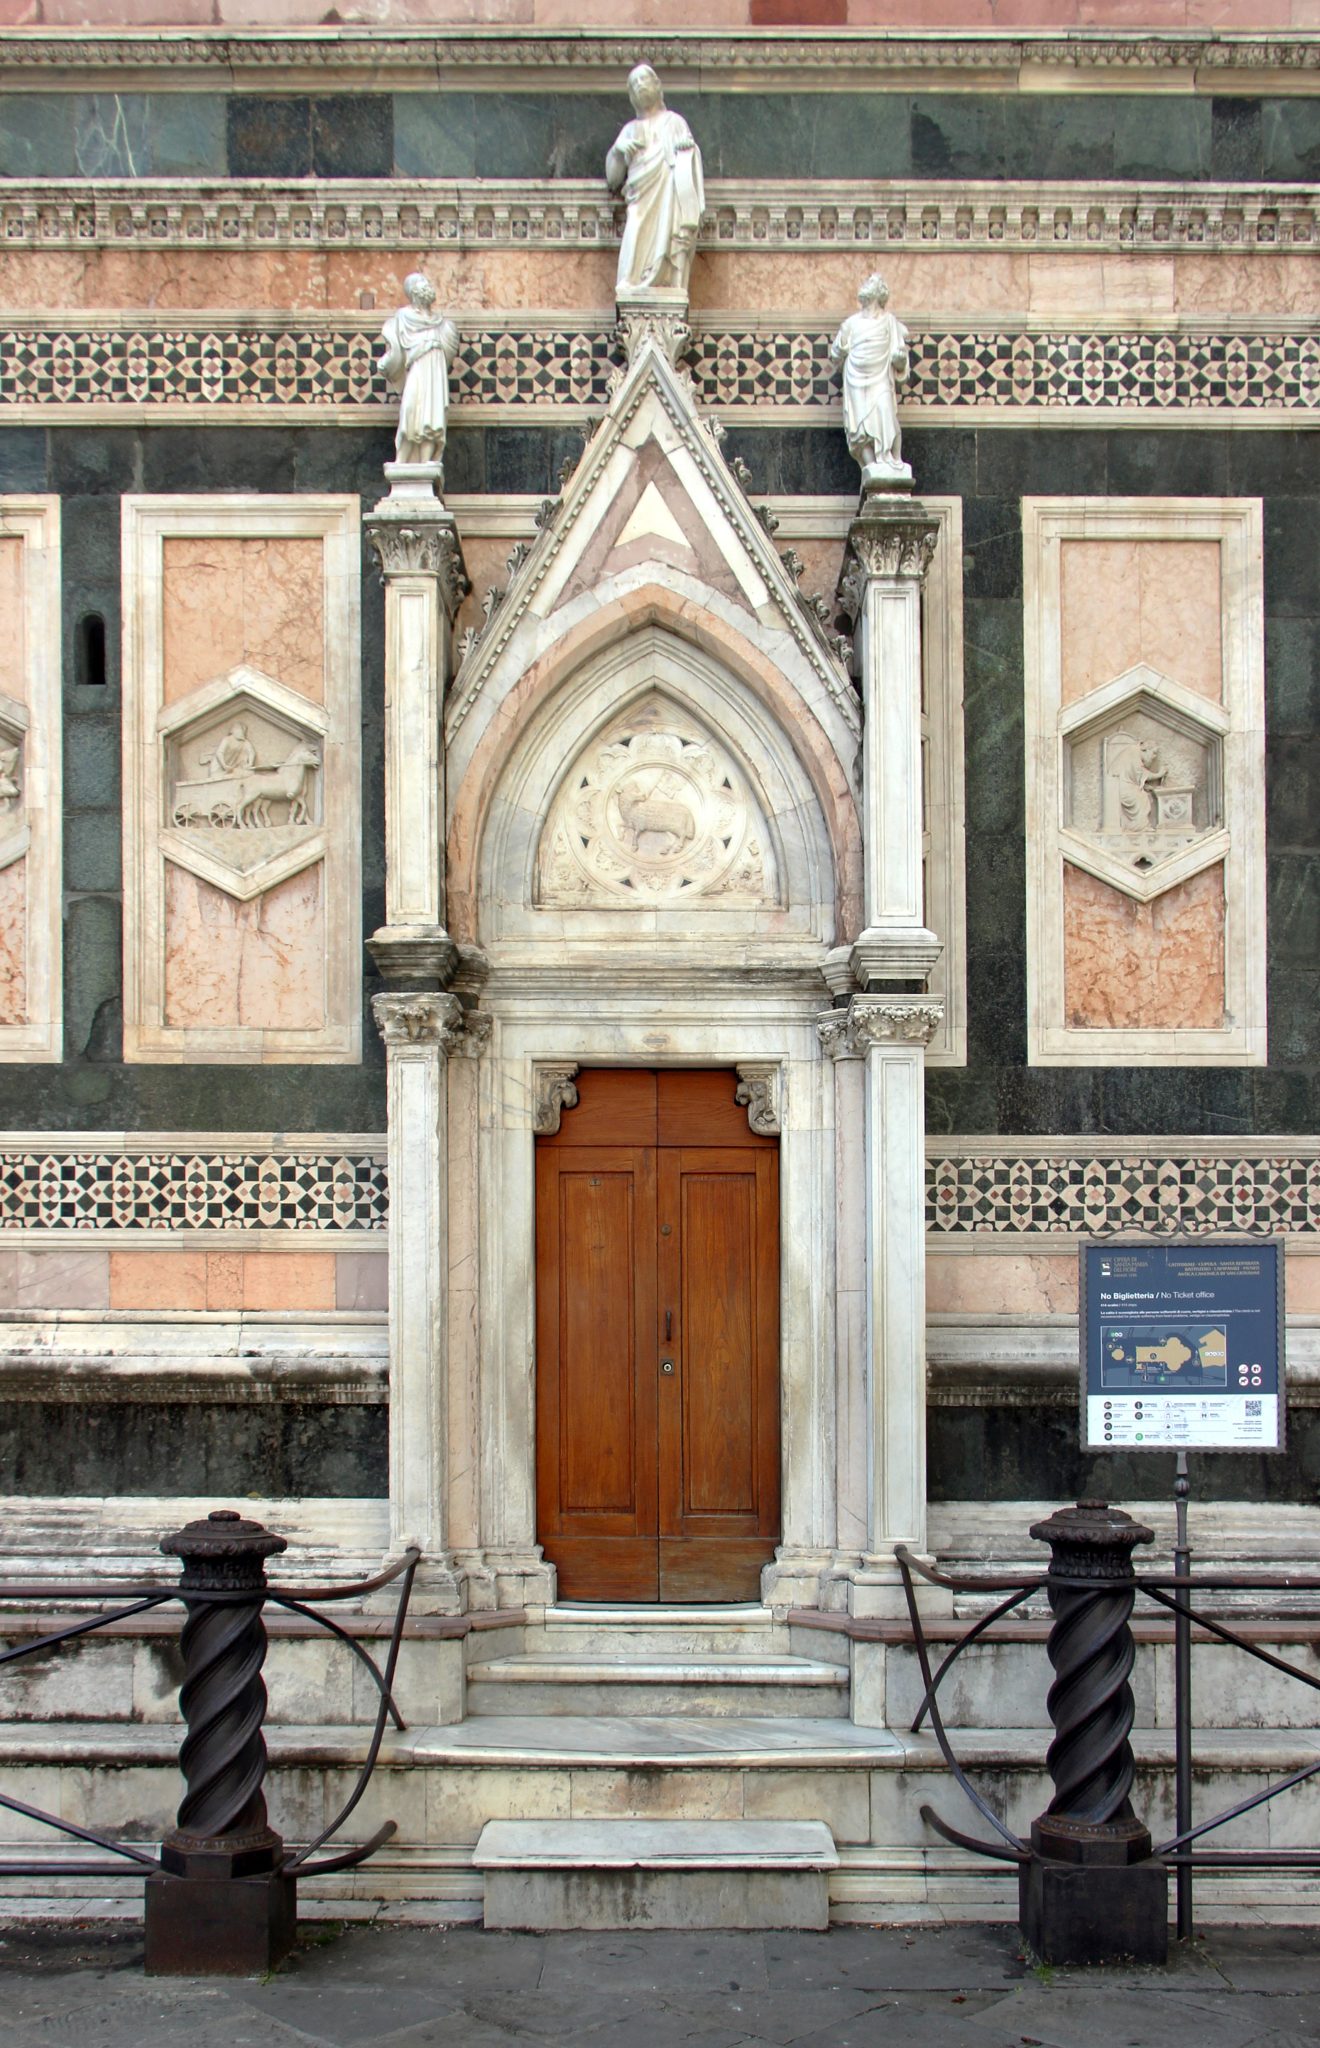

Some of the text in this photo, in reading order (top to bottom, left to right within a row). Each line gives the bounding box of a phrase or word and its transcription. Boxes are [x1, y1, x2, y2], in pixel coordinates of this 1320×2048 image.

[1100, 1292, 1112, 1300] No
[1113, 1291, 1154, 1301] Biglietteria
[1160, 1291, 1172, 1299] No
[1173, 1291, 1194, 1299] Ticket
